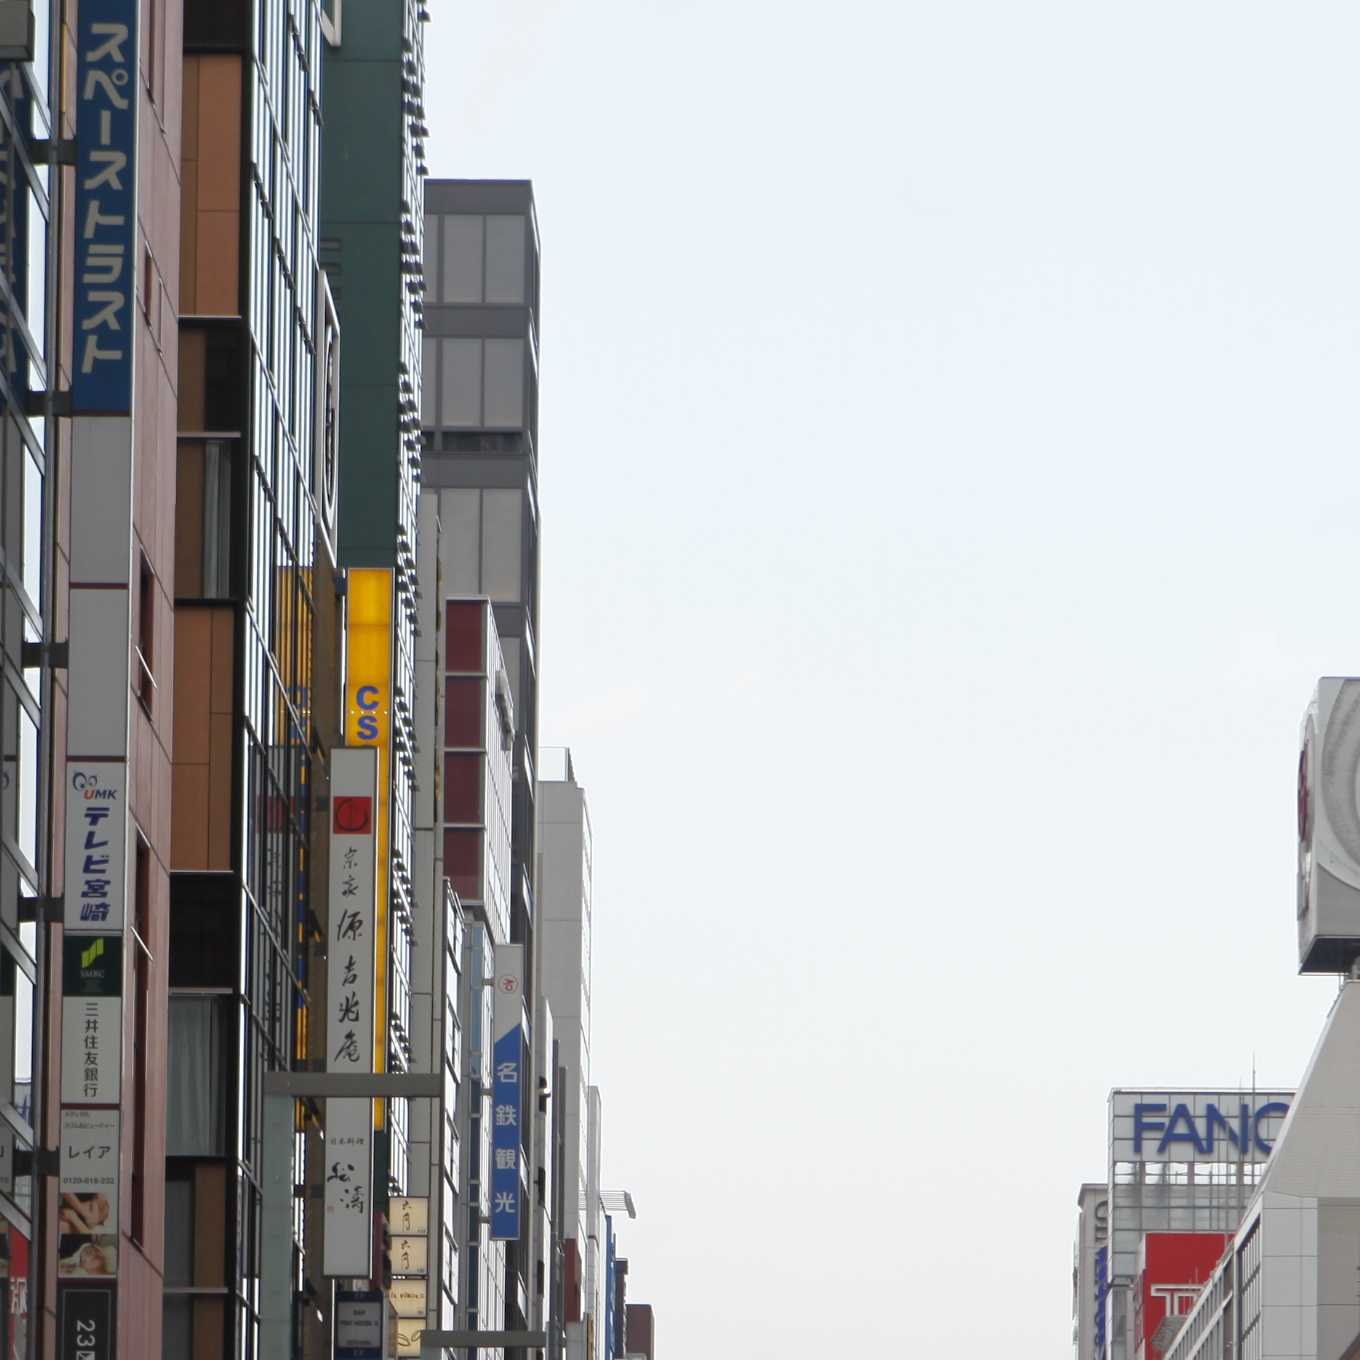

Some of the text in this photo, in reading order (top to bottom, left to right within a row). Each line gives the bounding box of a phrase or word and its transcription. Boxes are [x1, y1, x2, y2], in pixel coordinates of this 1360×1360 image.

[81, 22, 129, 375] スペーストラスト
[83, 789, 117, 800] UMK
[80, 807, 111, 921] テレビ宮崎
[83, 1001, 99, 1097] 三井住友銀行
[69, 1146, 112, 1160] レイア
[495, 1062, 518, 1213] 名鉄観光
[1133, 1102, 1290, 1154] FANC
